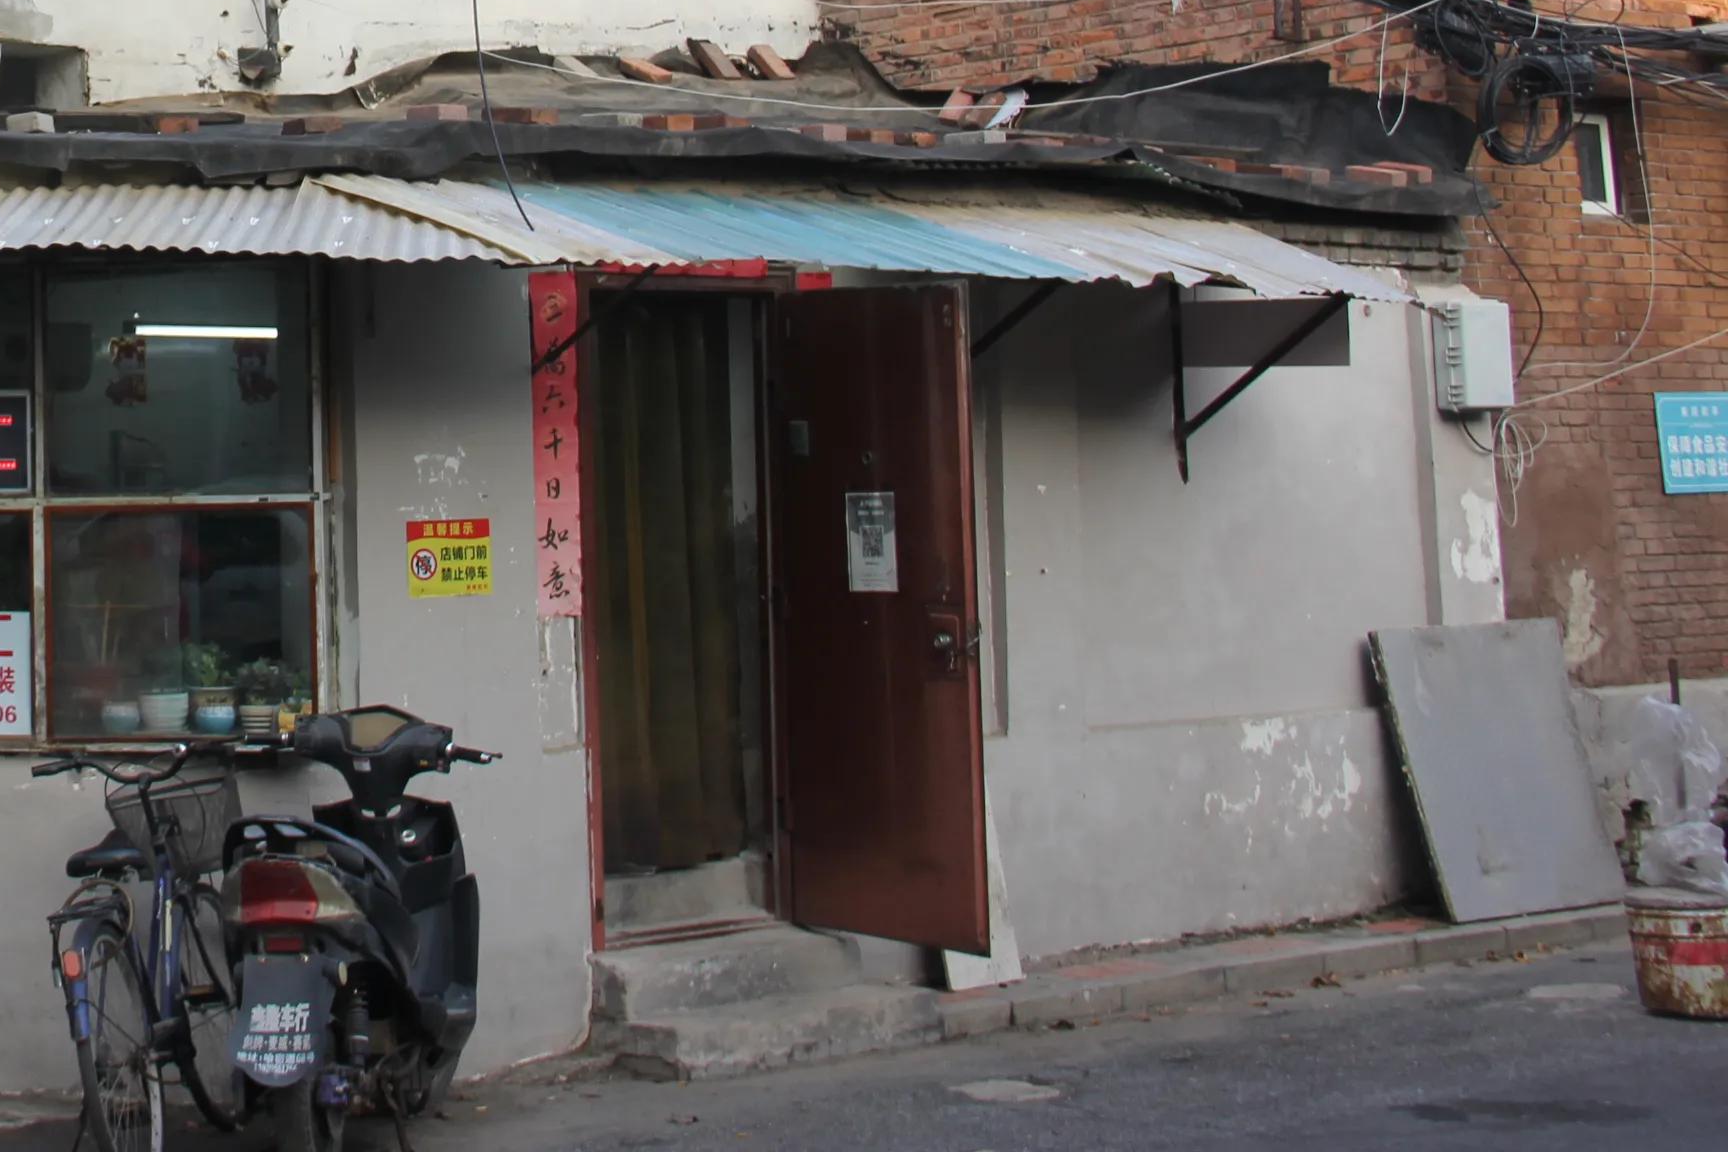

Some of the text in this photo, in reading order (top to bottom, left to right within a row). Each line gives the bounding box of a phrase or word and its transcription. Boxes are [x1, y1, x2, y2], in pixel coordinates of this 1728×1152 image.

[440, 544, 487, 561] 店铺门前
[441, 566, 488, 582] 禁止停车
